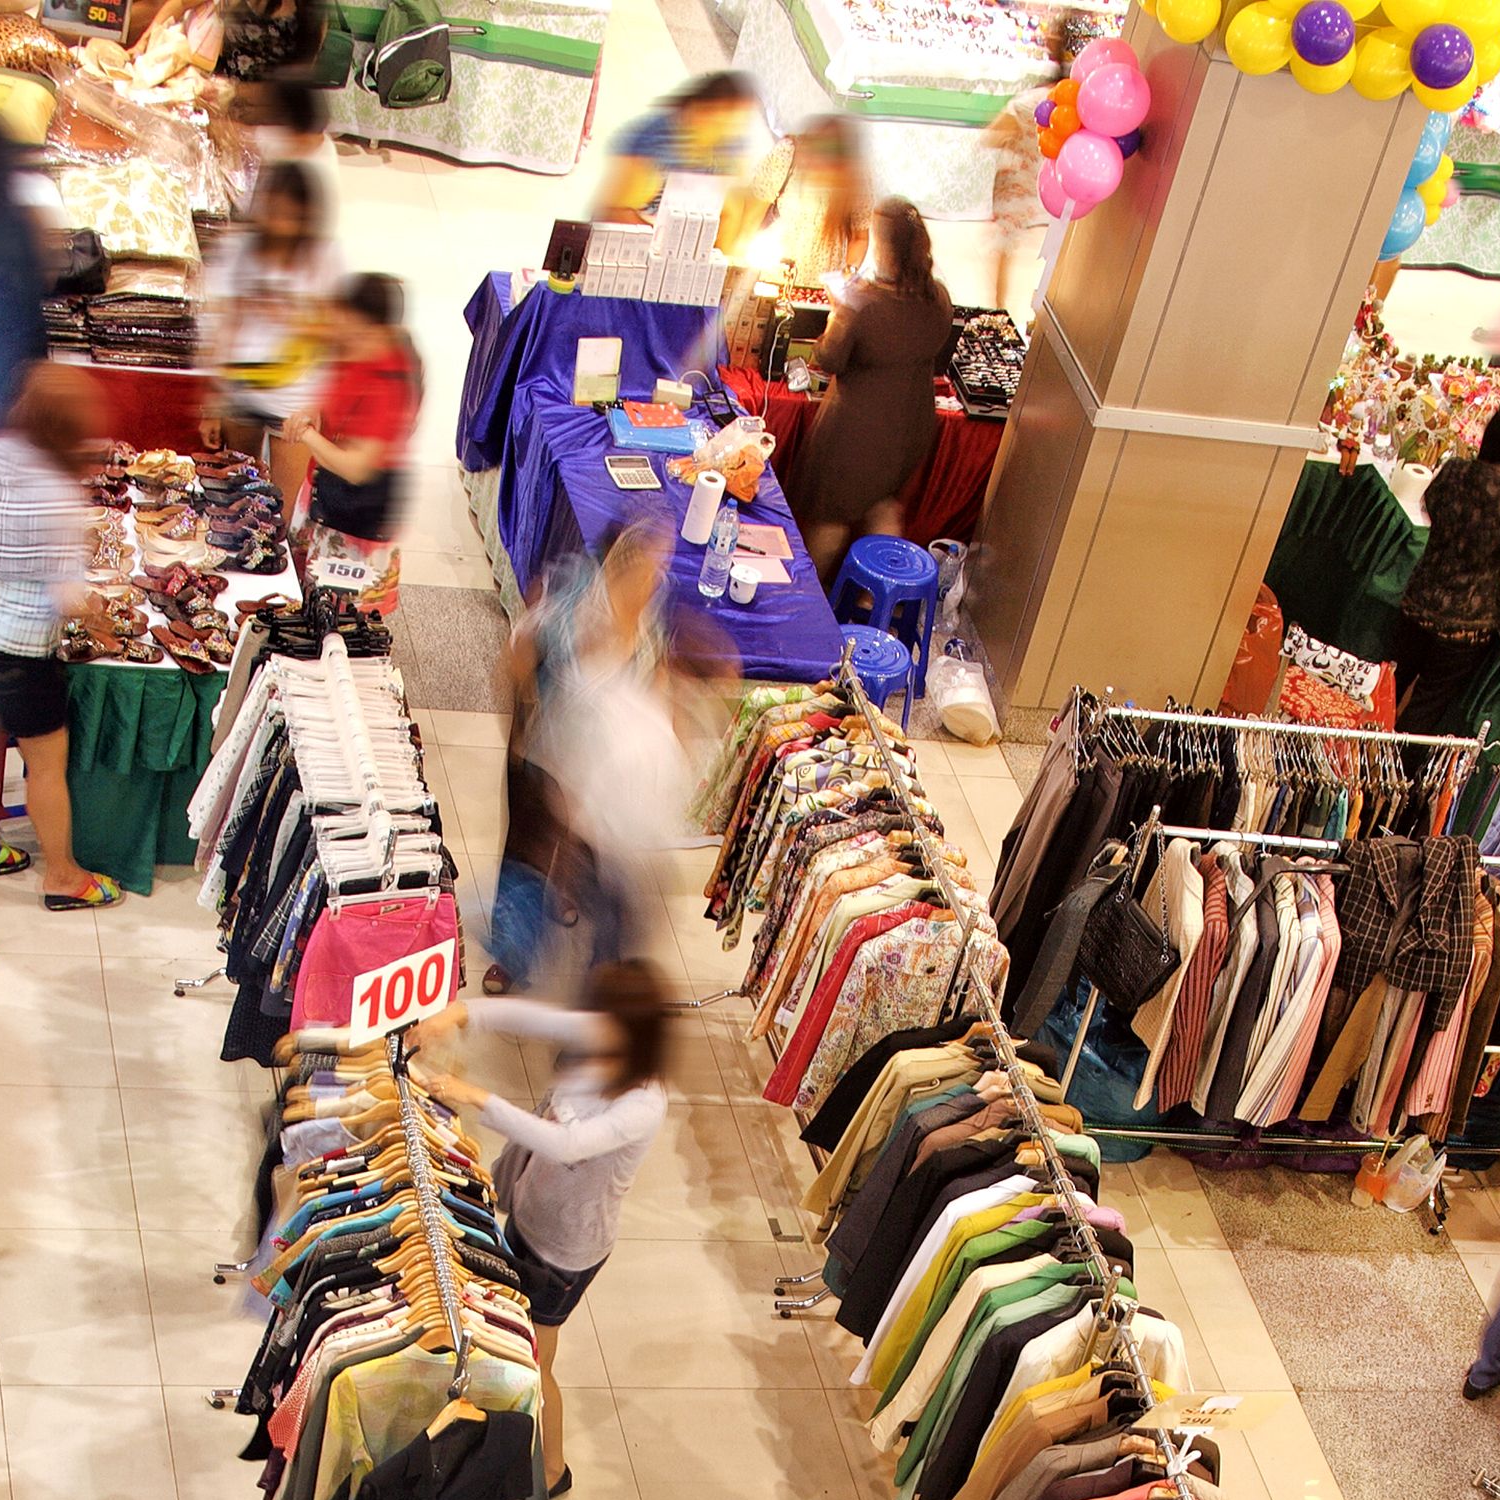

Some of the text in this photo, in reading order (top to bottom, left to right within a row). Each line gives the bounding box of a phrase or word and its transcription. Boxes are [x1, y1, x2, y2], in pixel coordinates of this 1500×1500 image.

[328, 563, 366, 579] 150
[359, 953, 445, 1028] 100
[1179, 1417, 1212, 1425] 290
